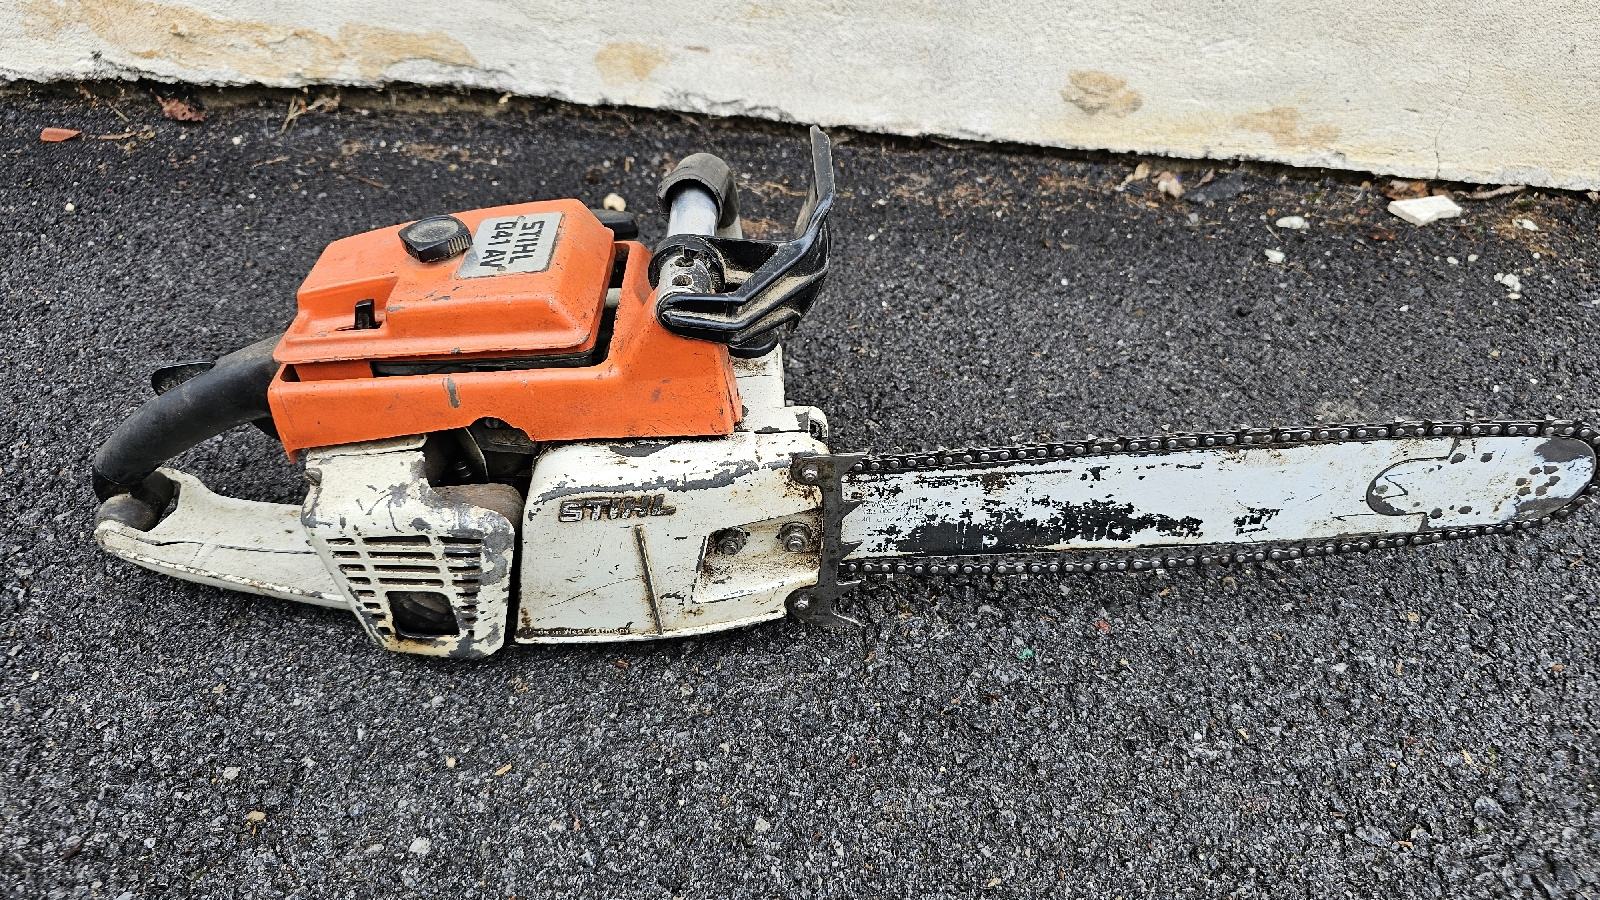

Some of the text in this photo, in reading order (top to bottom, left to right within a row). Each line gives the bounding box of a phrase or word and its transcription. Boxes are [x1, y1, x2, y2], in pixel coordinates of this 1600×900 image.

[480, 222, 518, 266] 041 AV
[508, 220, 545, 264] STIHL
[559, 494, 676, 522] STIHL
